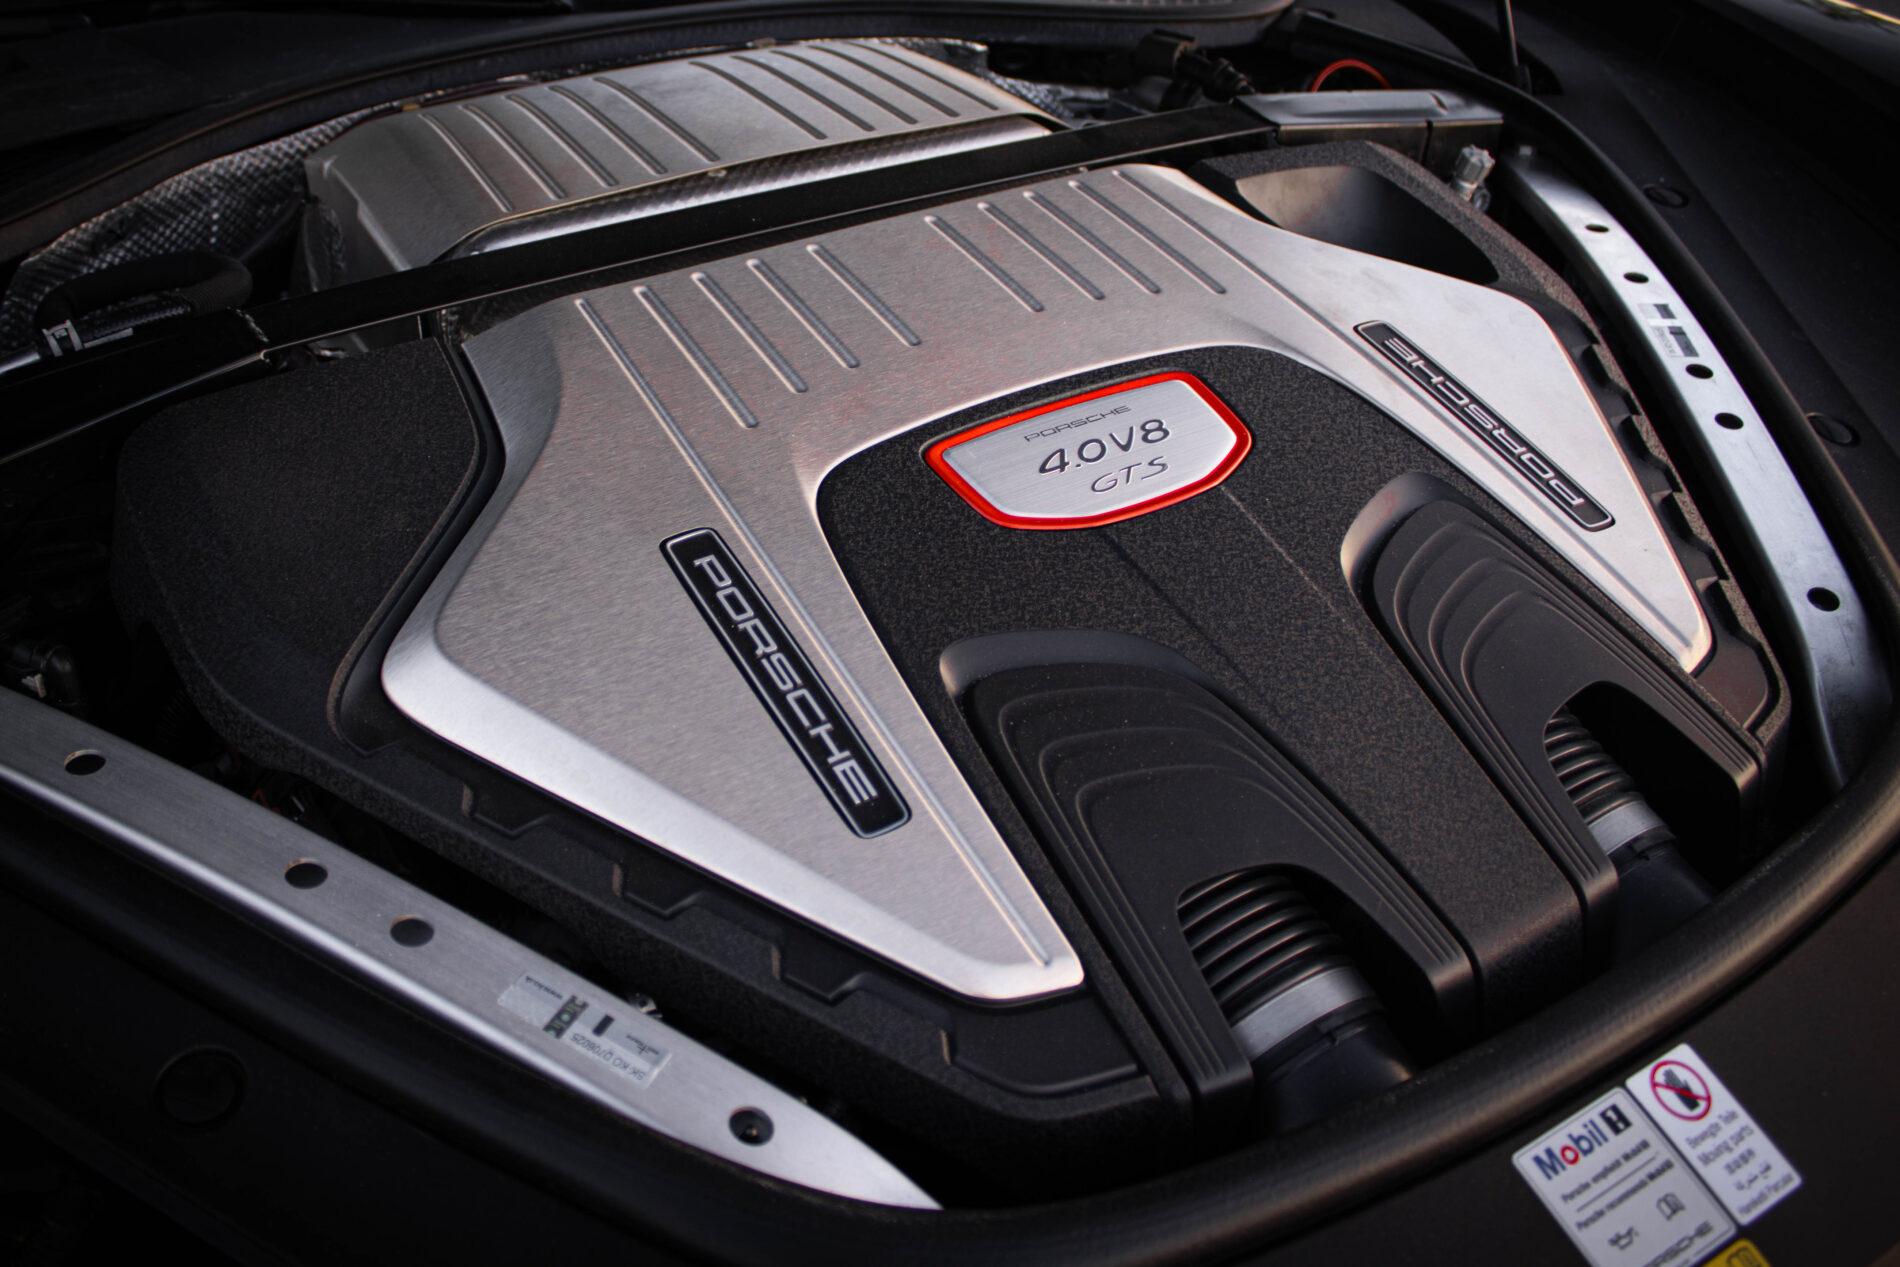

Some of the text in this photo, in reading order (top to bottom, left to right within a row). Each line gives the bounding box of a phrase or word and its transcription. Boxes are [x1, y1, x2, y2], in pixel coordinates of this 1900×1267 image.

[1024, 405, 1132, 442] PORSCHE
[1384, 337, 1585, 506] PORSCHE
[1091, 456, 1169, 493] GTS
[693, 554, 878, 806] PORSCHE
[1533, 1119, 1609, 1180] Mobil
